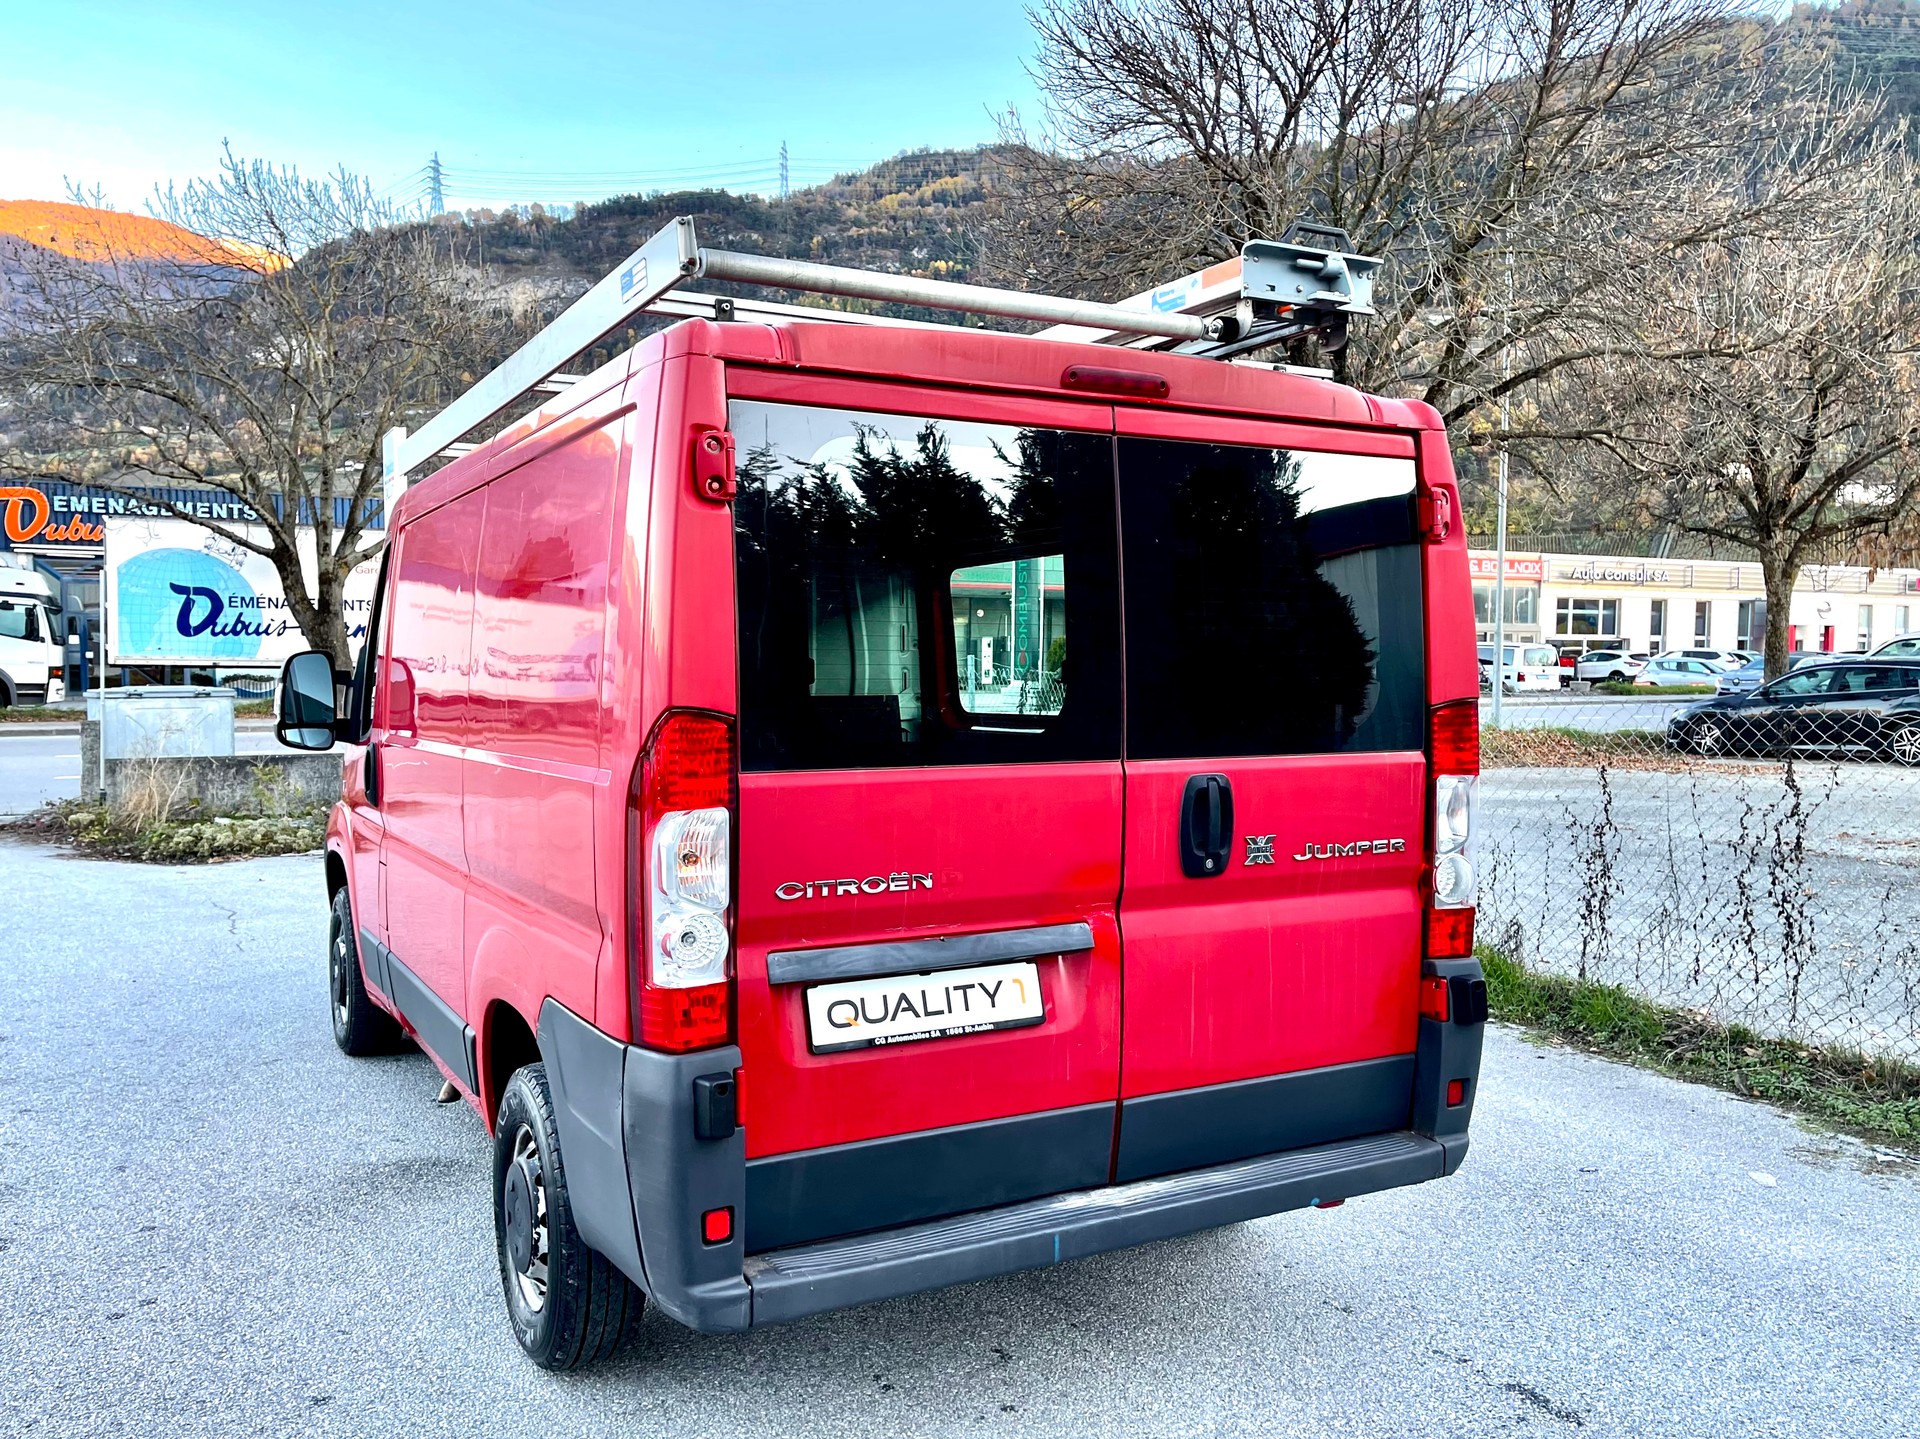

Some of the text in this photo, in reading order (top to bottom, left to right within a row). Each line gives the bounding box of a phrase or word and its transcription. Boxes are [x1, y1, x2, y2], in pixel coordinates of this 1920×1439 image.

[1573, 567, 1670, 582] Auto Consult SA
[1293, 838, 1405, 861] JUMPER
[775, 872, 933, 900] CITROËN
[827, 980, 1003, 1029] QUALITY
[874, 1037, 886, 1046] CG
[887, 1032, 930, 1044] Automobiles
[930, 1029, 941, 1038] SA
[964, 1023, 994, 1033] St-Aubin
